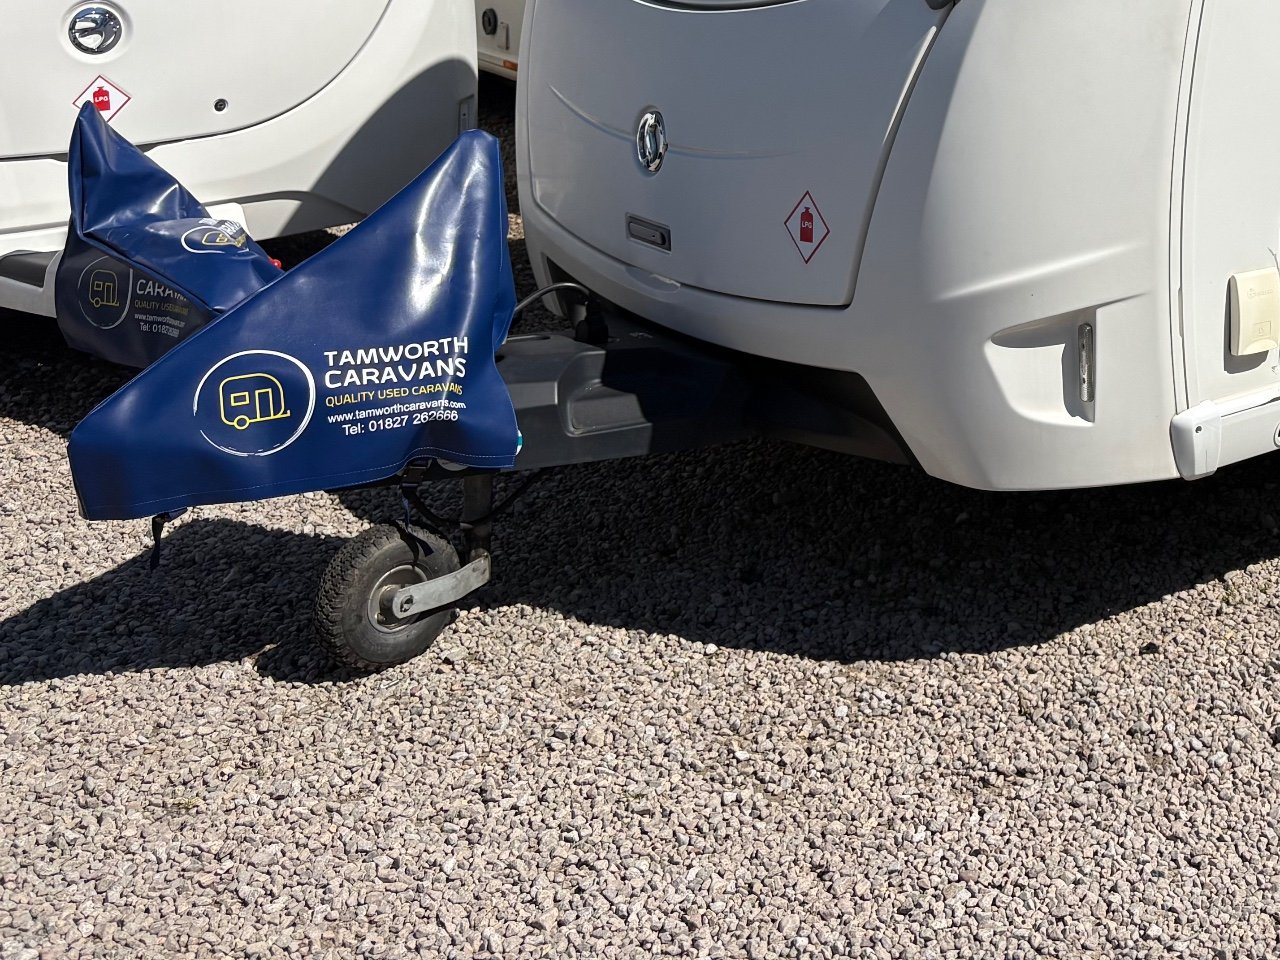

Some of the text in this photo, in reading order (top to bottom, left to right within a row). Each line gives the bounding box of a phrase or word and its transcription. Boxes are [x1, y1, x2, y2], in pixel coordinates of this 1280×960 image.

[801, 221, 813, 229] LPG
[323, 336, 469, 367] TAMWORTH
[324, 357, 467, 389] CARAVANS
[325, 382, 463, 407] QUALITY USED CARAVANS
[327, 399, 467, 424] www.tamworthcaravans.com
[342, 410, 459, 436] Tel: 01827 262666
